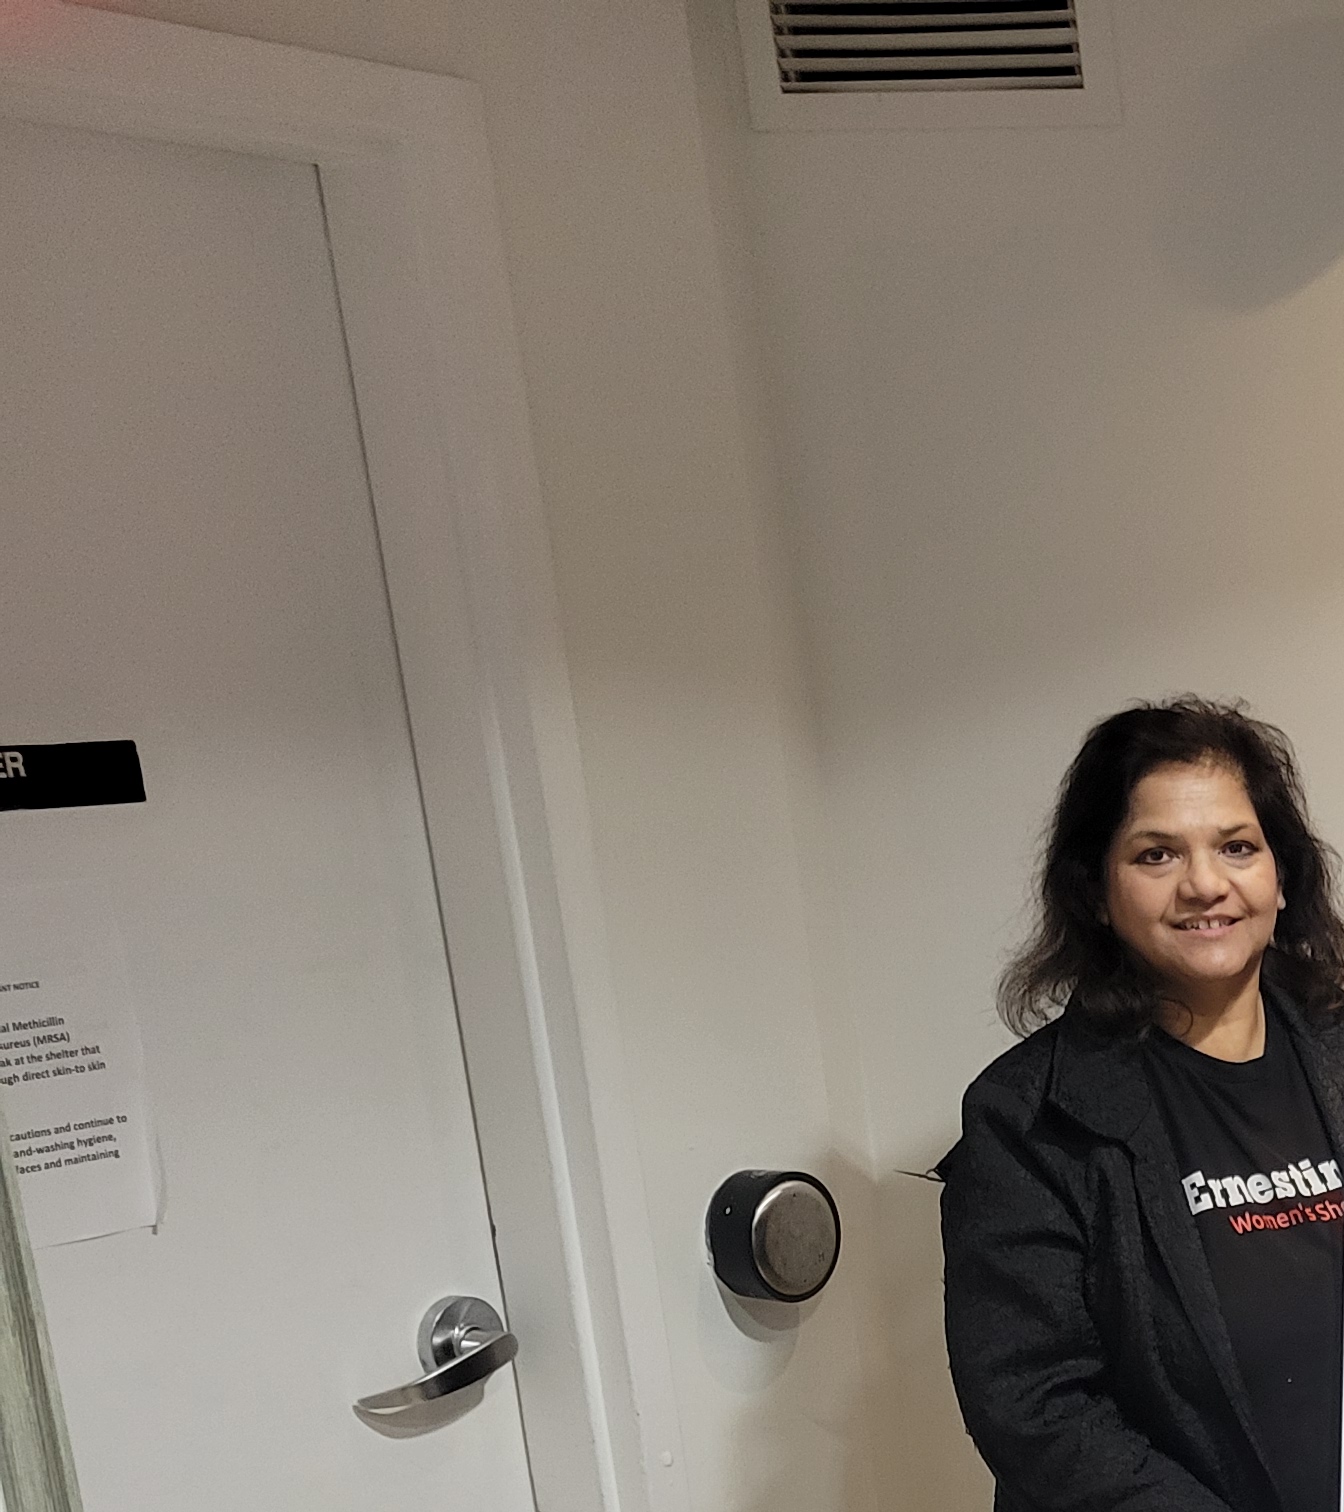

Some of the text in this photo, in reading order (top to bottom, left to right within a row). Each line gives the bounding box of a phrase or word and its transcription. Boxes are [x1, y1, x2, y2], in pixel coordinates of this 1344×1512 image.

[13, 980, 40, 991] NOTICE
[0, 1016, 65, 1033] al Methicillin
[33, 1031, 70, 1048] (MRSA)
[14, 1056, 25, 1066] at
[26, 1053, 43, 1064] the
[45, 1048, 79, 1061] shelter
[81, 1045, 101, 1056] that
[22, 1069, 51, 1082] direct
[52, 1062, 86, 1077] skin-to
[87, 1060, 106, 1072] skin
[54, 1122, 71, 1135] and
[73, 1117, 115, 1131] continue
[116, 1114, 128, 1124] to
[13, 1133, 117, 1158] and-washing hygiene,
[44, 1157, 63, 1170] and
[64, 1149, 120, 1166] maintaining
[1228, 1203, 1318, 1235] Women's
